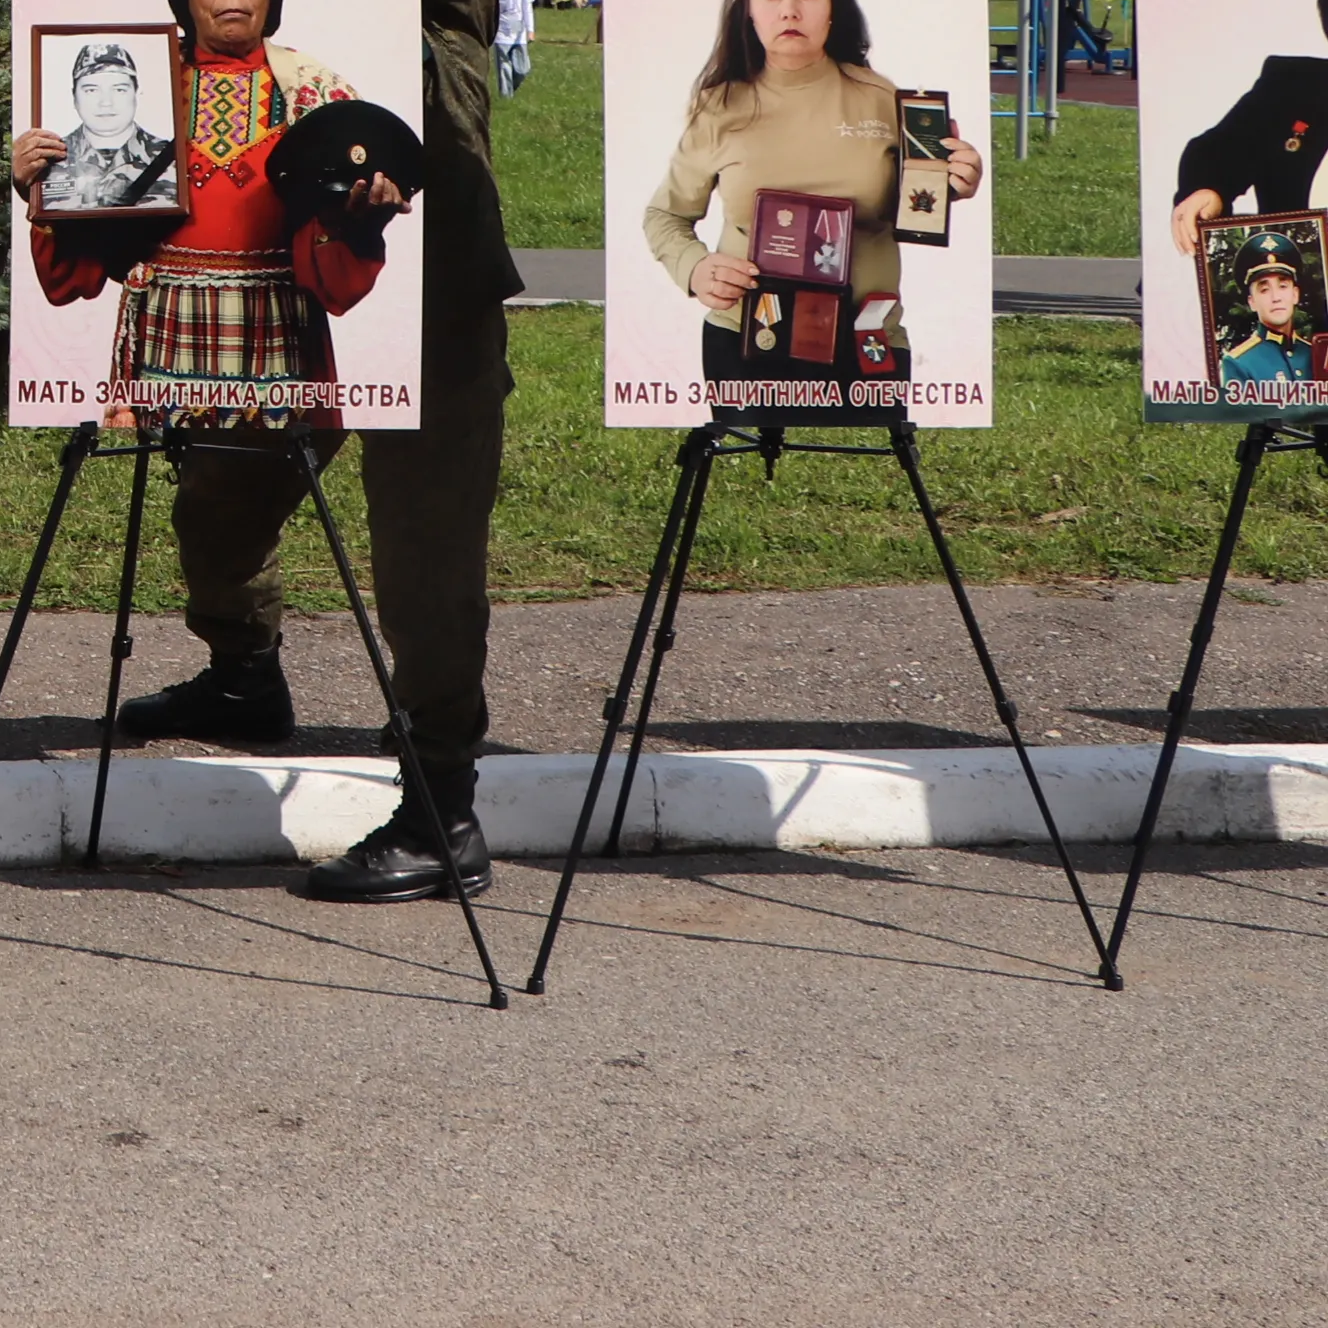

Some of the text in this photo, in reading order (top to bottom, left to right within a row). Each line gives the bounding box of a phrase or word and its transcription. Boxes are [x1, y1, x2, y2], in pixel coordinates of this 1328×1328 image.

[17, 379, 412, 410] МАТЬ ЗАЩИТНИКА ОТЕЧЕСТВА
[613, 381, 985, 411] МАТЬ ЗАЩИТНИКА ОТЕЧЕСТВА
[1152, 380, 1328, 409] МАТЬ ЗАЩИТН
